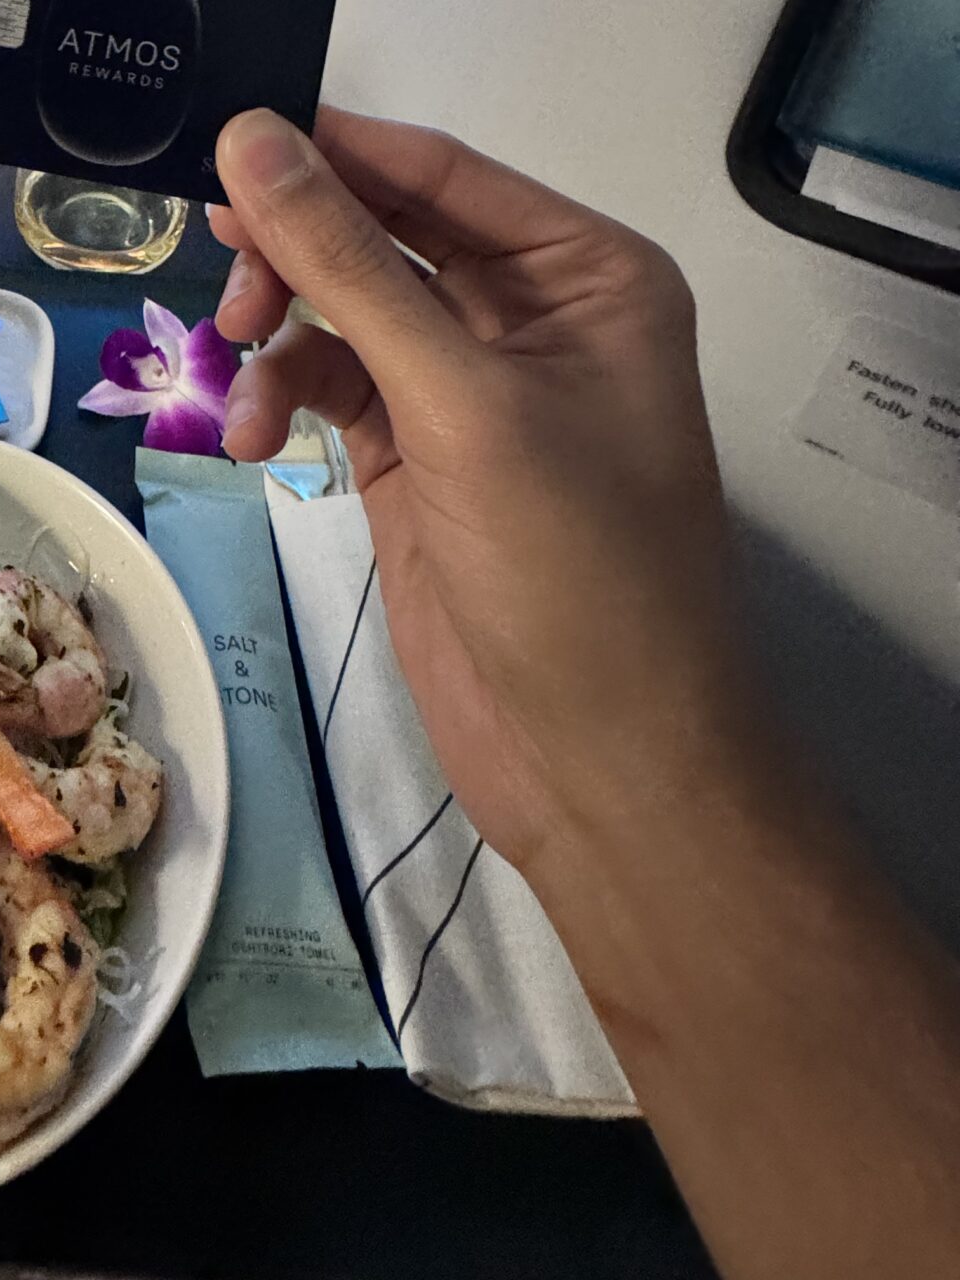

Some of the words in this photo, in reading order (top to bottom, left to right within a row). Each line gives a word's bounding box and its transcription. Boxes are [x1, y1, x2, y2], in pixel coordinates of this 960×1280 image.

[58, 27, 181, 72] ATMOS
[68, 61, 166, 90] REWARDS
[847, 359, 919, 397] Fasten
[862, 390, 913, 420] Fully
[213, 634, 258, 655] SALT
[234, 659, 250, 678] &
[220, 686, 278, 713] TONE
